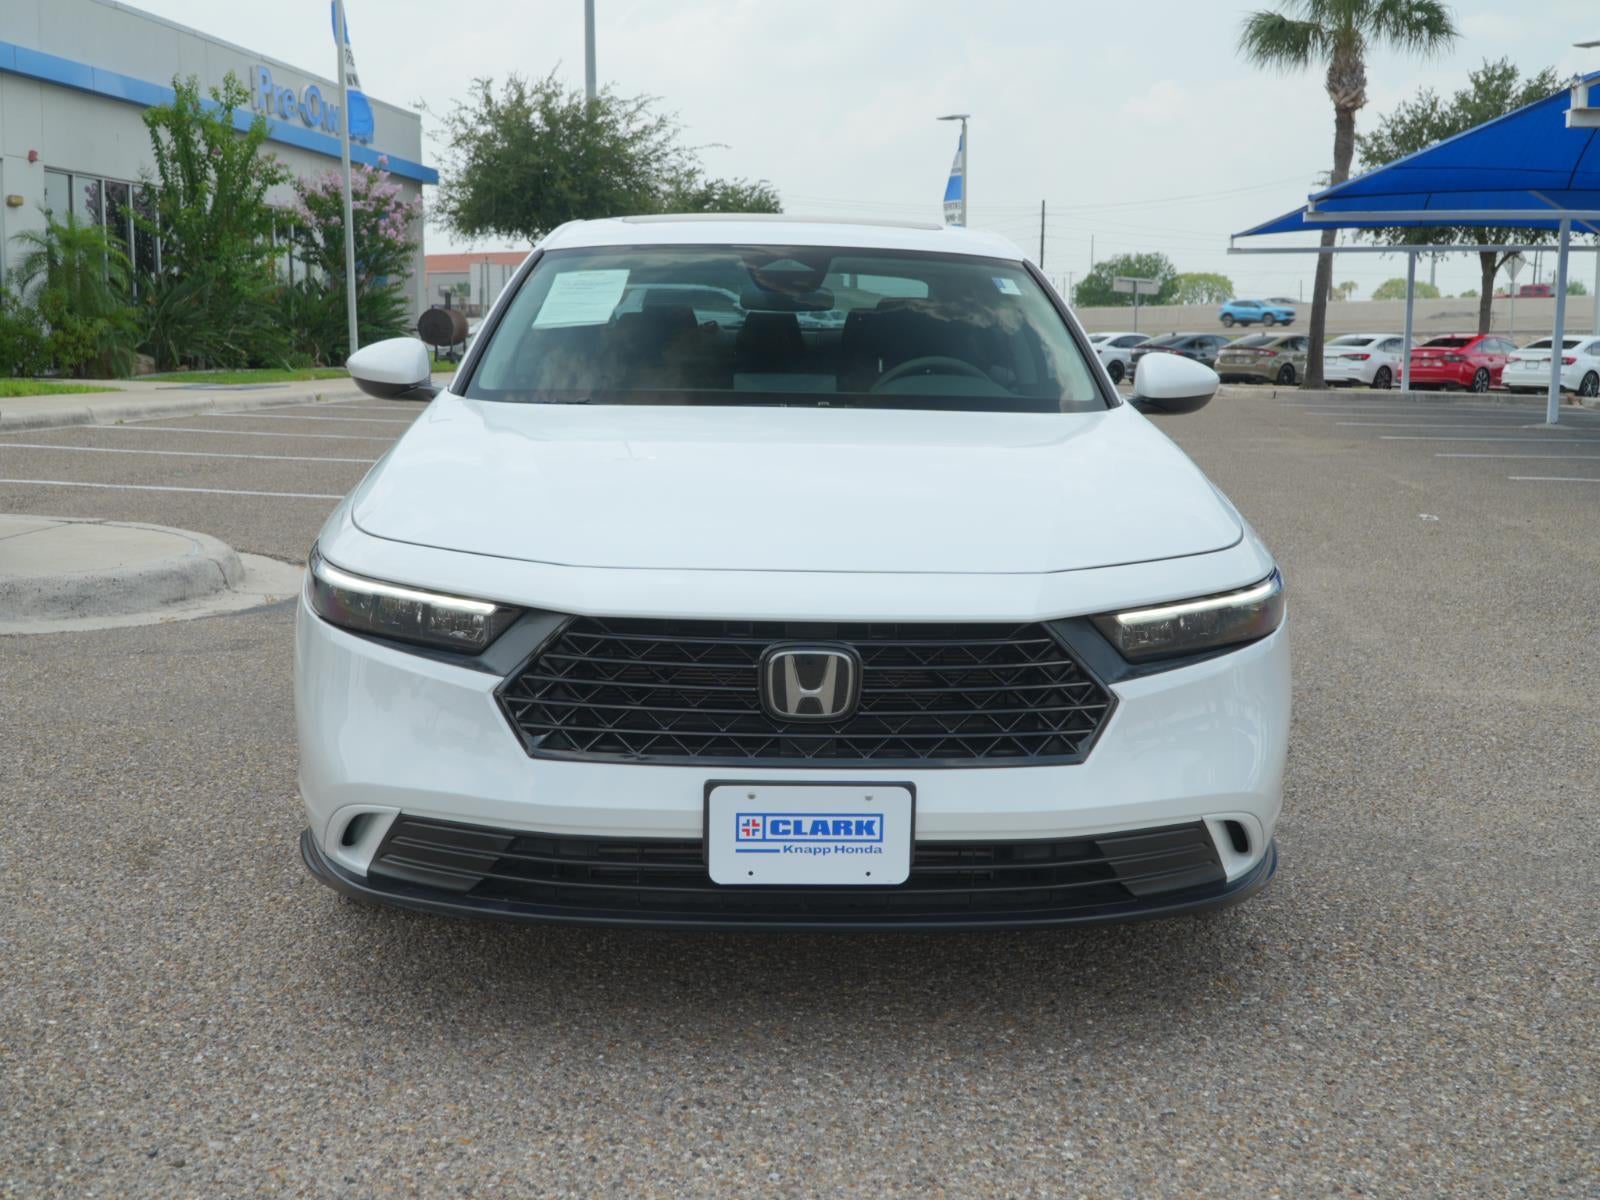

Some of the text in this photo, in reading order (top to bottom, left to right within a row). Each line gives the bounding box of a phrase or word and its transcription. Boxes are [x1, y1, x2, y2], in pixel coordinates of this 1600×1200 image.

[769, 819, 877, 836] CLARK
[783, 844, 883, 856] Knapp Honda
